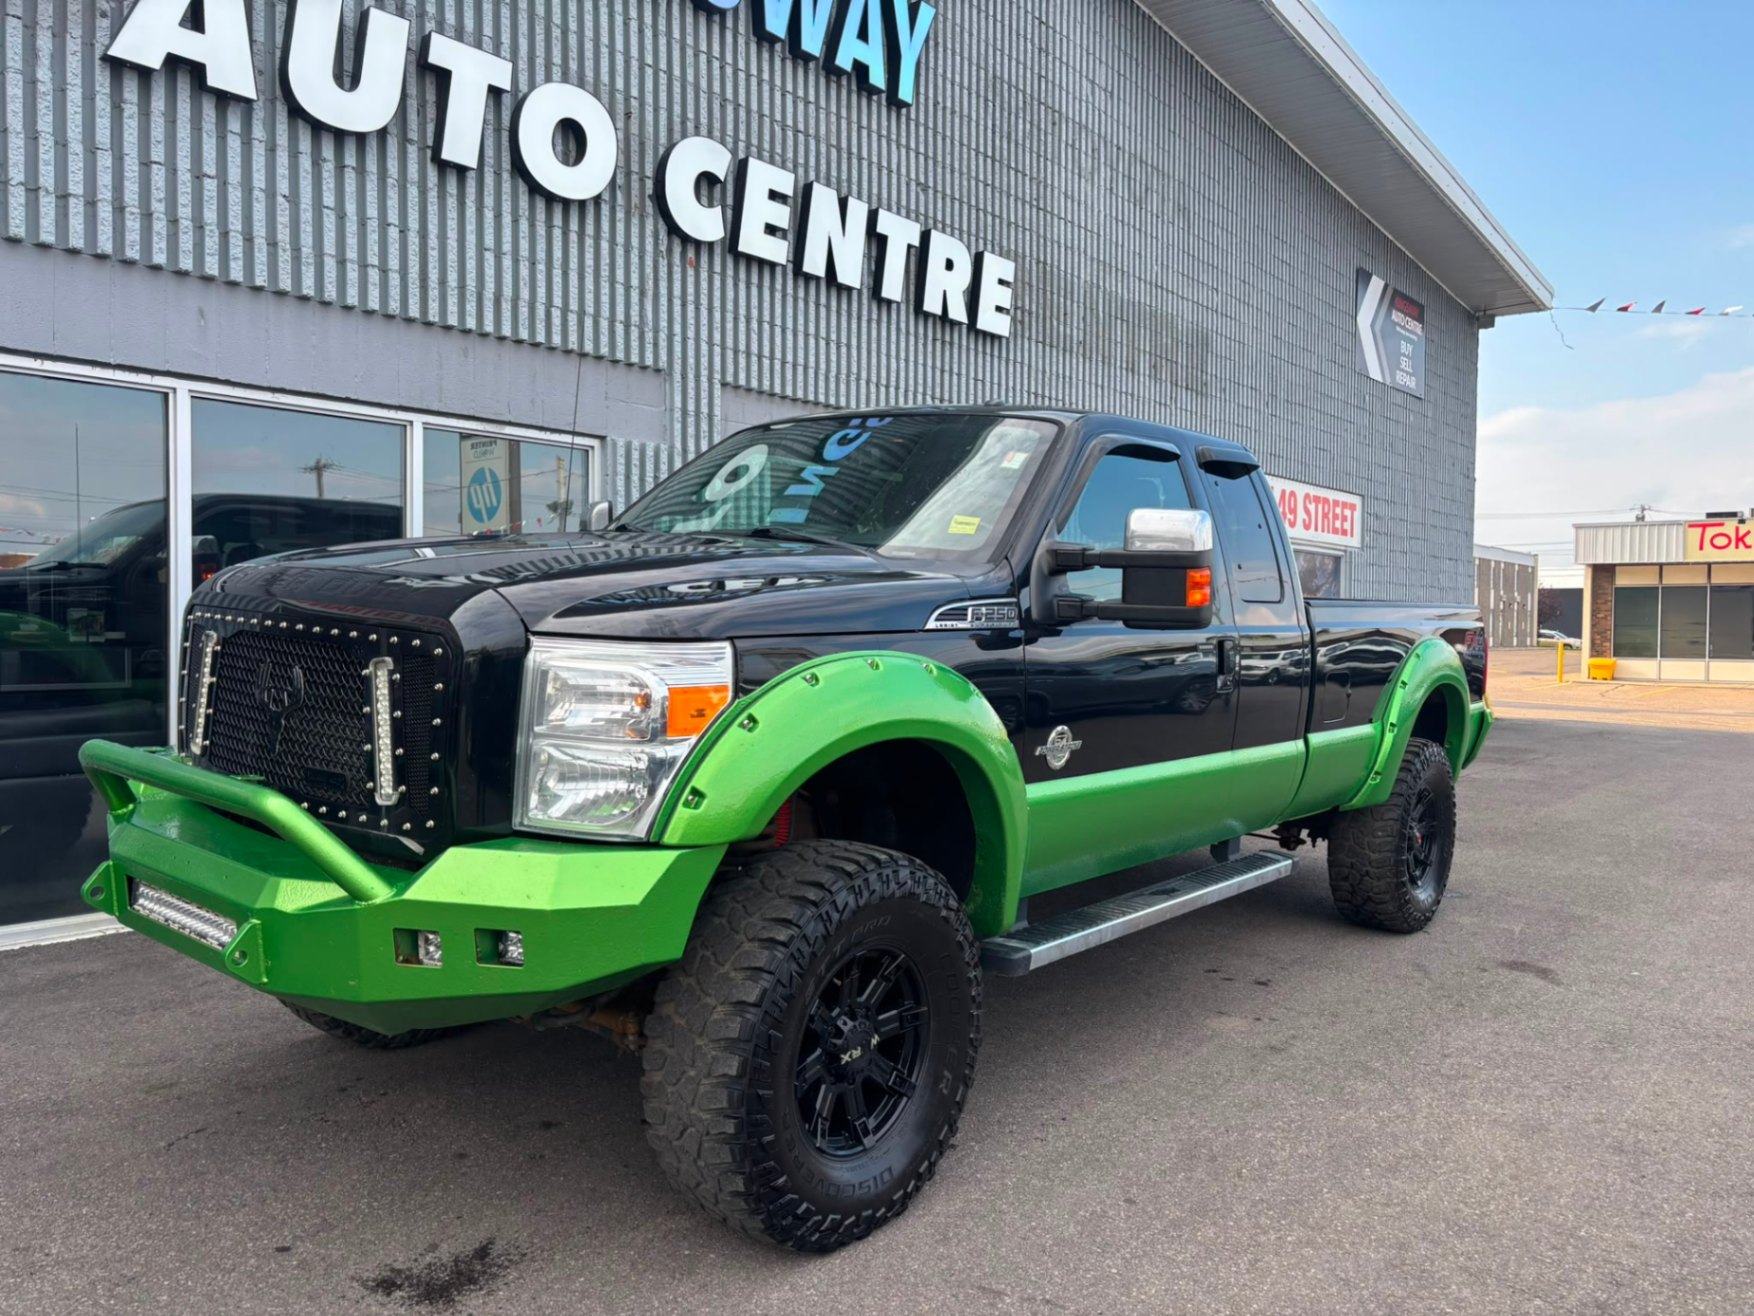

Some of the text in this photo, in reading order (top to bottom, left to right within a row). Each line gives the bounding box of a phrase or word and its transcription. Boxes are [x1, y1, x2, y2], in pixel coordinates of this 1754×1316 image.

[103, 0, 1015, 338] AUTO CENTRE
[1400, 341, 1414, 357] BUY
[1399, 356, 1414, 373] SELL
[1396, 369, 1417, 389] REPAIR
[1278, 488, 1357, 538] 49 STREET
[1687, 521, 1752, 551] Tok
